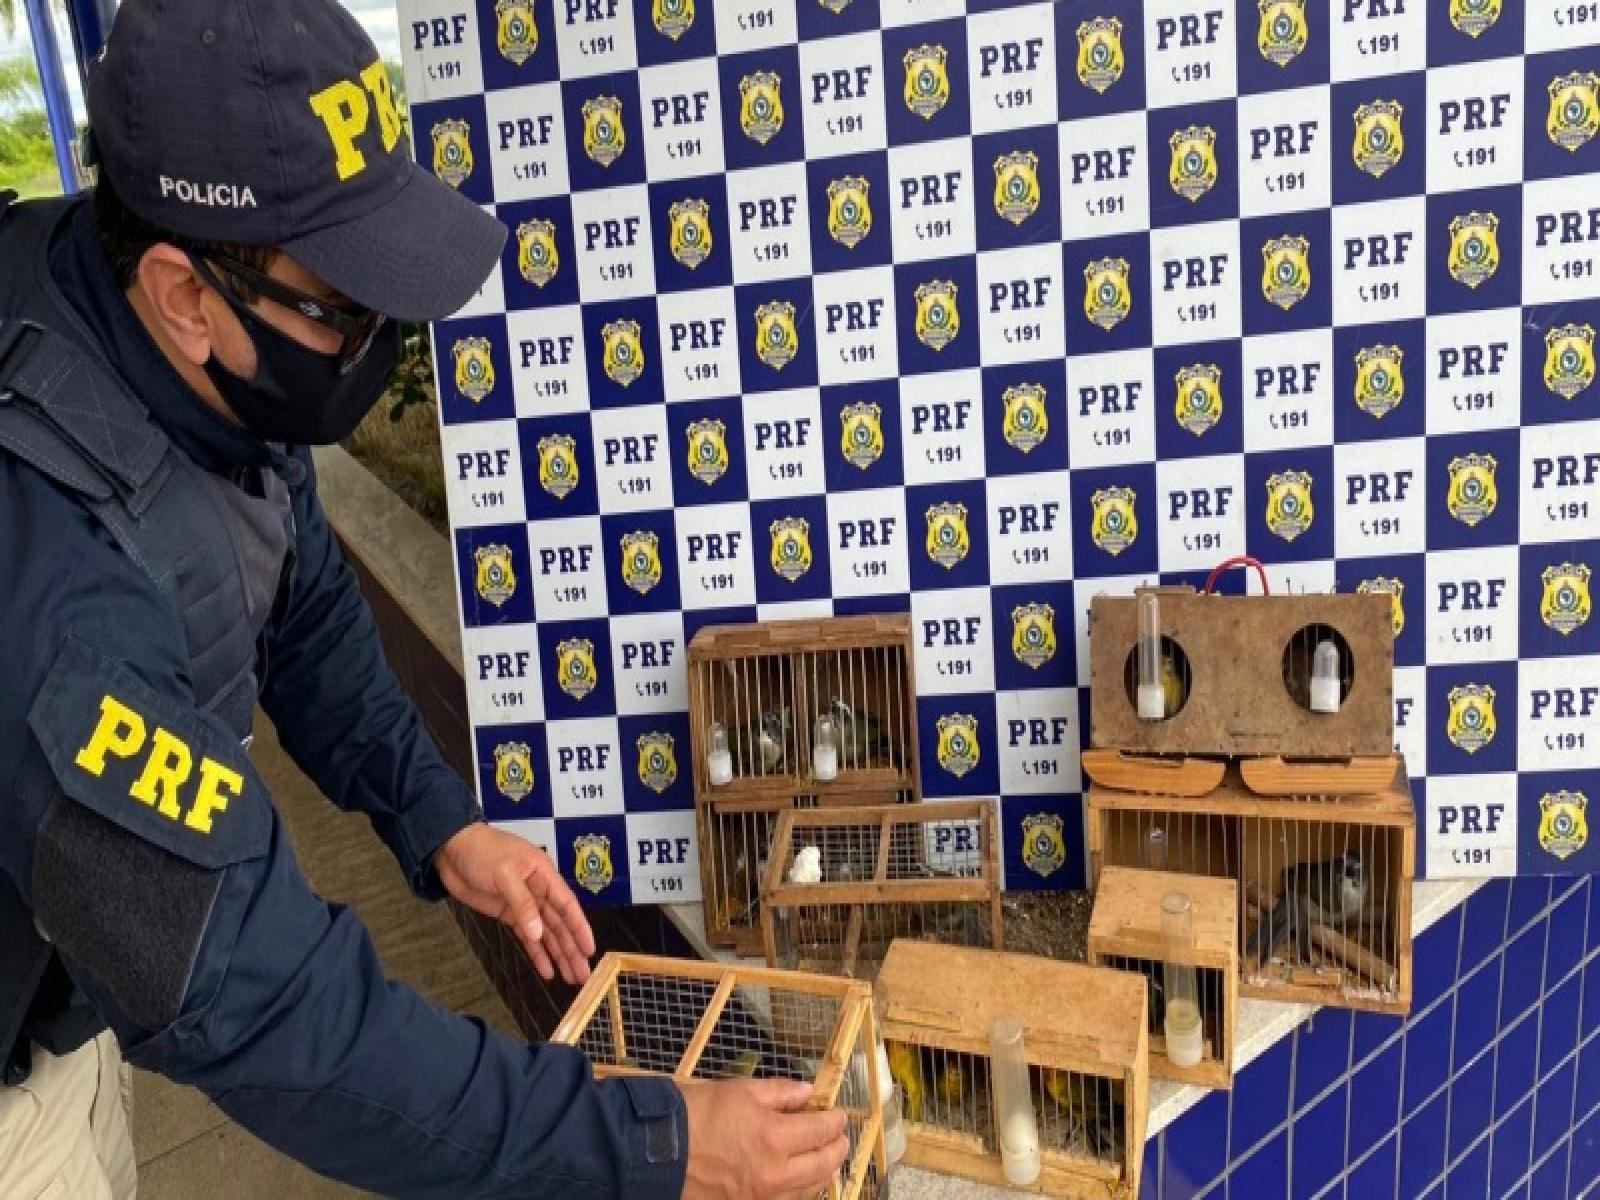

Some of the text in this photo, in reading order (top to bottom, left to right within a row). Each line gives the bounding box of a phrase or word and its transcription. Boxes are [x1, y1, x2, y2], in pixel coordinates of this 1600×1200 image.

[747, 9, 773, 29] 191
[1567, 2, 1597, 25] 191
[411, 12, 468, 52] PRF
[1156, 10, 1223, 51] PRF
[589, 34, 614, 55] 191
[1369, 34, 1399, 55] 191
[979, 37, 1043, 79] PRF
[437, 61, 461, 79] 191
[1183, 61, 1211, 82] 191
[811, 64, 872, 104] PRF
[651, 90, 709, 129] PRF
[1005, 88, 1033, 109] 191
[309, 59, 401, 181] PR
[837, 115, 863, 133] 191
[1439, 93, 1511, 136] PRF
[497, 114, 554, 152] PRF
[1250, 120, 1318, 160] PRF
[677, 139, 701, 158] 191
[1465, 146, 1495, 166] 191
[523, 161, 547, 179] 191
[1071, 145, 1135, 185] PRF
[899, 171, 961, 209] PRF
[1277, 172, 1305, 192] 191
[738, 195, 797, 232] PRF
[1097, 195, 1124, 214] 191
[583, 215, 641, 252] PRF
[925, 219, 951, 238] 191
[1535, 207, 1600, 246] PRF
[763, 242, 789, 260] 191
[1344, 231, 1413, 271] PRF
[609, 263, 633, 280] 191
[1162, 254, 1229, 292] PRF
[1563, 258, 1593, 279] 191
[989, 276, 1052, 314] PRF
[1370, 282, 1399, 301] 191
[825, 298, 885, 334] PRF
[1189, 303, 1216, 322] 191
[669, 317, 726, 352] PRF
[1015, 324, 1041, 342] 191
[518, 335, 574, 369] PRF
[849, 344, 875, 363] 191
[1438, 341, 1509, 379] PRF
[695, 363, 719, 381] 191
[1255, 362, 1321, 398] PRF
[544, 379, 567, 397] 191
[1079, 381, 1143, 417] PRF
[1465, 390, 1493, 411] 191
[911, 400, 972, 435] PRF
[1281, 409, 1308, 429] 191
[754, 417, 811, 451] PRF
[1104, 428, 1131, 446] 191
[603, 433, 659, 466] PRF
[936, 445, 961, 463] 191
[456, 449, 511, 481] PRF
[779, 462, 803, 479] 191
[1532, 452, 1600, 489] PRF
[628, 476, 651, 493] 191
[1346, 470, 1413, 505] PRF
[481, 490, 505, 508] 191
[1168, 487, 1233, 521] PRF
[1559, 501, 1588, 520] 191
[997, 502, 1059, 535] PRF
[1371, 517, 1399, 535] 191
[838, 517, 896, 549] PRF
[1194, 533, 1221, 551] 191
[686, 530, 742, 563] PRF
[1023, 547, 1049, 564] 191
[539, 544, 593, 576] PRF
[863, 560, 887, 578] 191
[711, 573, 734, 590] 191
[563, 586, 587, 602] 191
[1437, 578, 1506, 613] PRF
[922, 616, 981, 648] PRF
[1463, 625, 1492, 643] 191
[621, 638, 676, 670] PRF
[477, 651, 531, 681] PRF
[947, 659, 972, 676] 191
[501, 691, 524, 707] 191
[644, 679, 669, 697] 191
[1530, 687, 1599, 719] PRF
[1007, 715, 1069, 748] PRF
[1557, 732, 1585, 750] 191
[75, 695, 244, 833] PRF
[557, 743, 611, 773] PRF
[1031, 759, 1059, 776] 191
[581, 783, 604, 799] 191
[1438, 803, 1505, 835] PRF
[934, 825, 982, 852] PR
[636, 836, 692, 867] PRF
[1463, 848, 1491, 864] 191
[658, 876, 683, 891] 191
